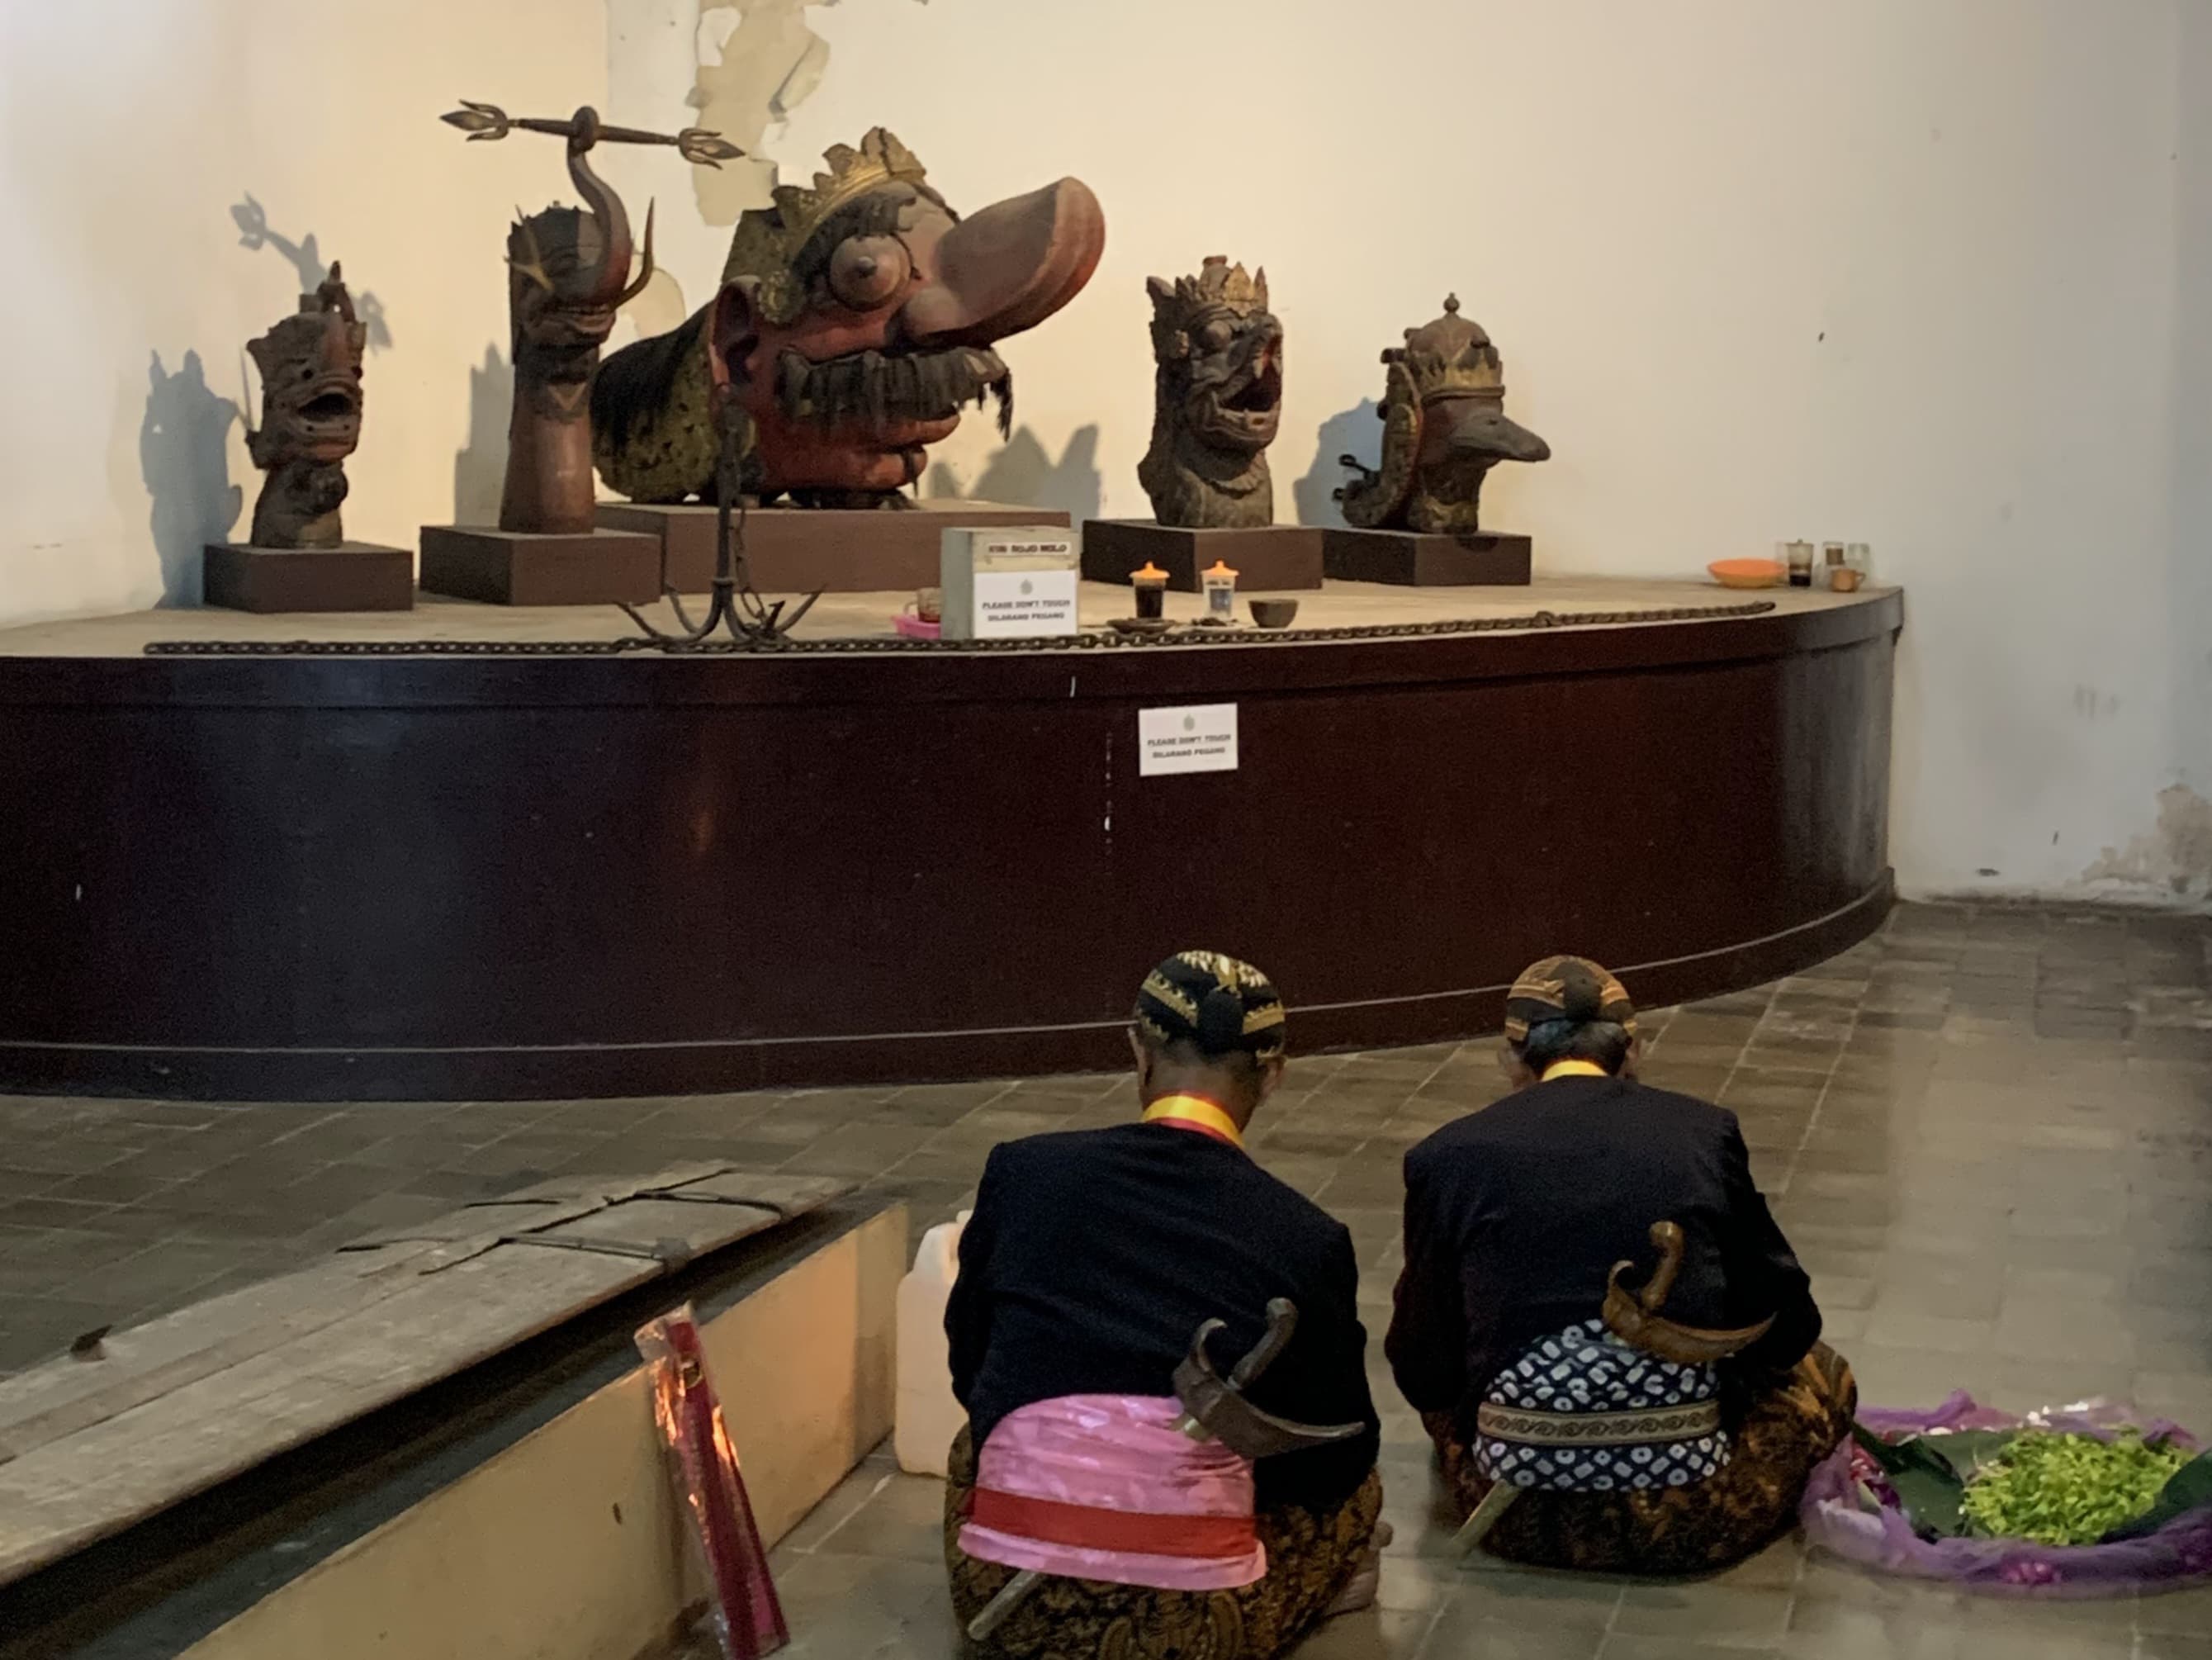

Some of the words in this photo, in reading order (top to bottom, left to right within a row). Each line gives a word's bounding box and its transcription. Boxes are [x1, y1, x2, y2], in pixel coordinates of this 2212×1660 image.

[983, 601, 1012, 609] PLEASE
[1016, 600, 1039, 609] DON'T
[1043, 599, 1070, 607] TOUCH
[1148, 738, 1176, 747] PLEASE
